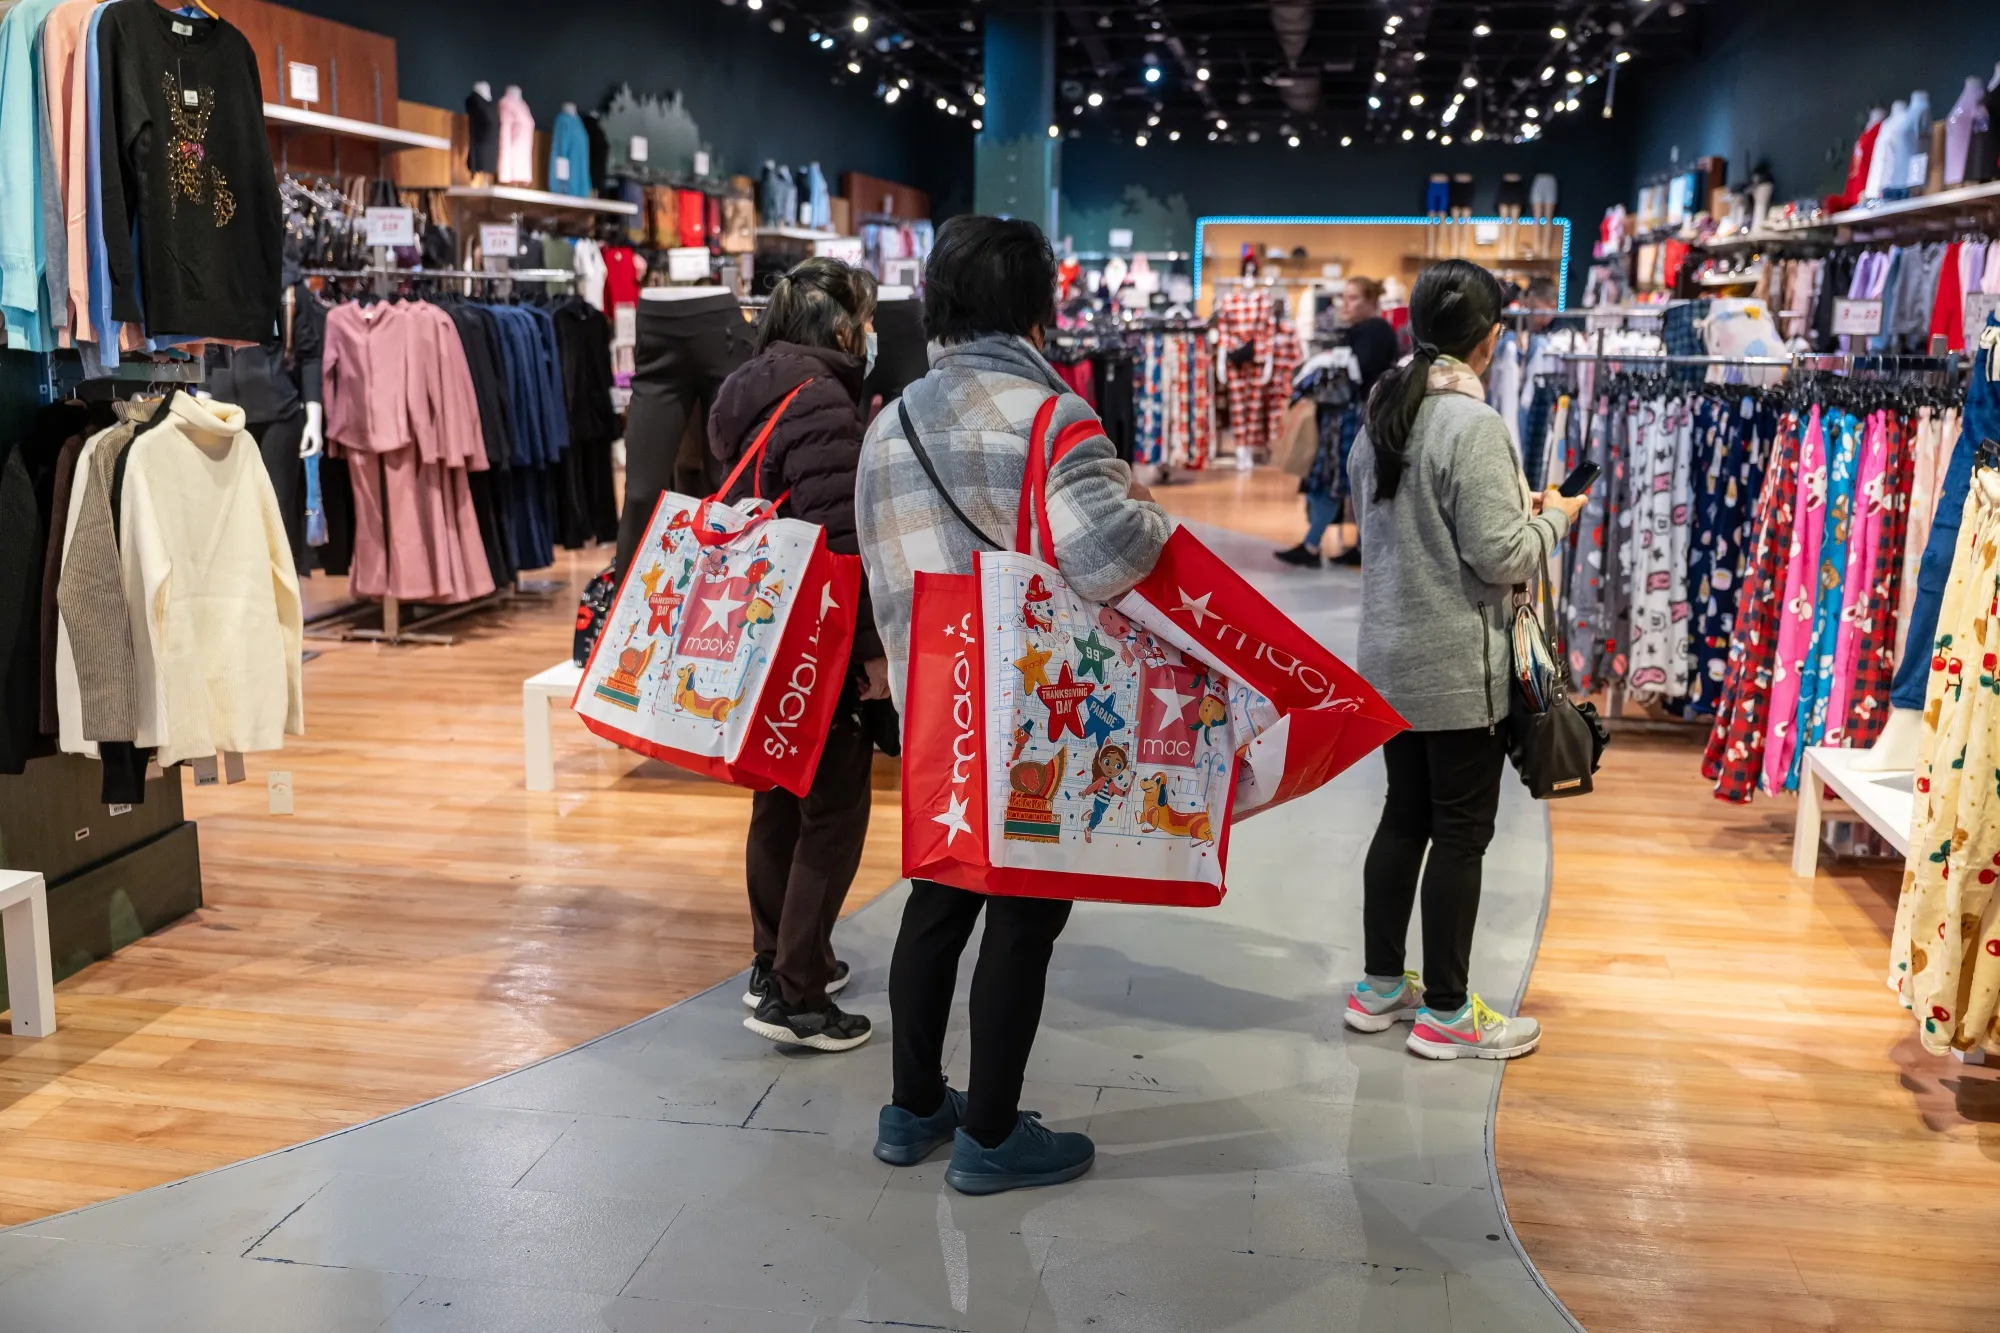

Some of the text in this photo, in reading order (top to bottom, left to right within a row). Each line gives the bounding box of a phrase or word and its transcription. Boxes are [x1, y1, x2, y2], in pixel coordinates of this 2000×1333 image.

[656, 605, 670, 617] DAY
[1041, 687, 1088, 700] THANKSGIVING
[1055, 699, 1073, 715] DAY
[1089, 700, 1118, 729] PARADE
